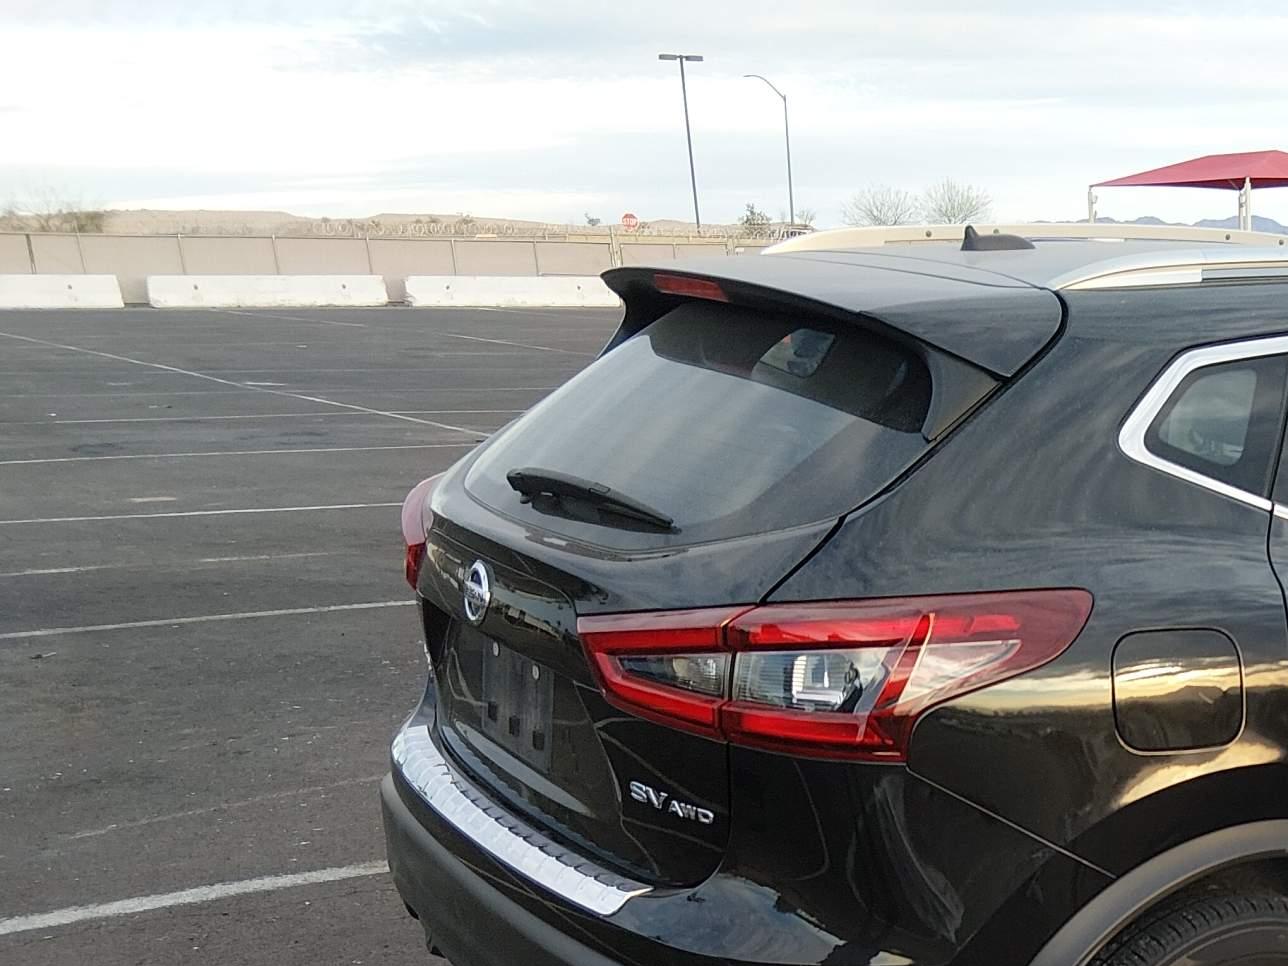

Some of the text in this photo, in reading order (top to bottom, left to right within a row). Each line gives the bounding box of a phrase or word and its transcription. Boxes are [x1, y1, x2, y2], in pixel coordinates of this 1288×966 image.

[623, 217, 638, 226] STOP
[630, 781, 715, 825] SV AWD
